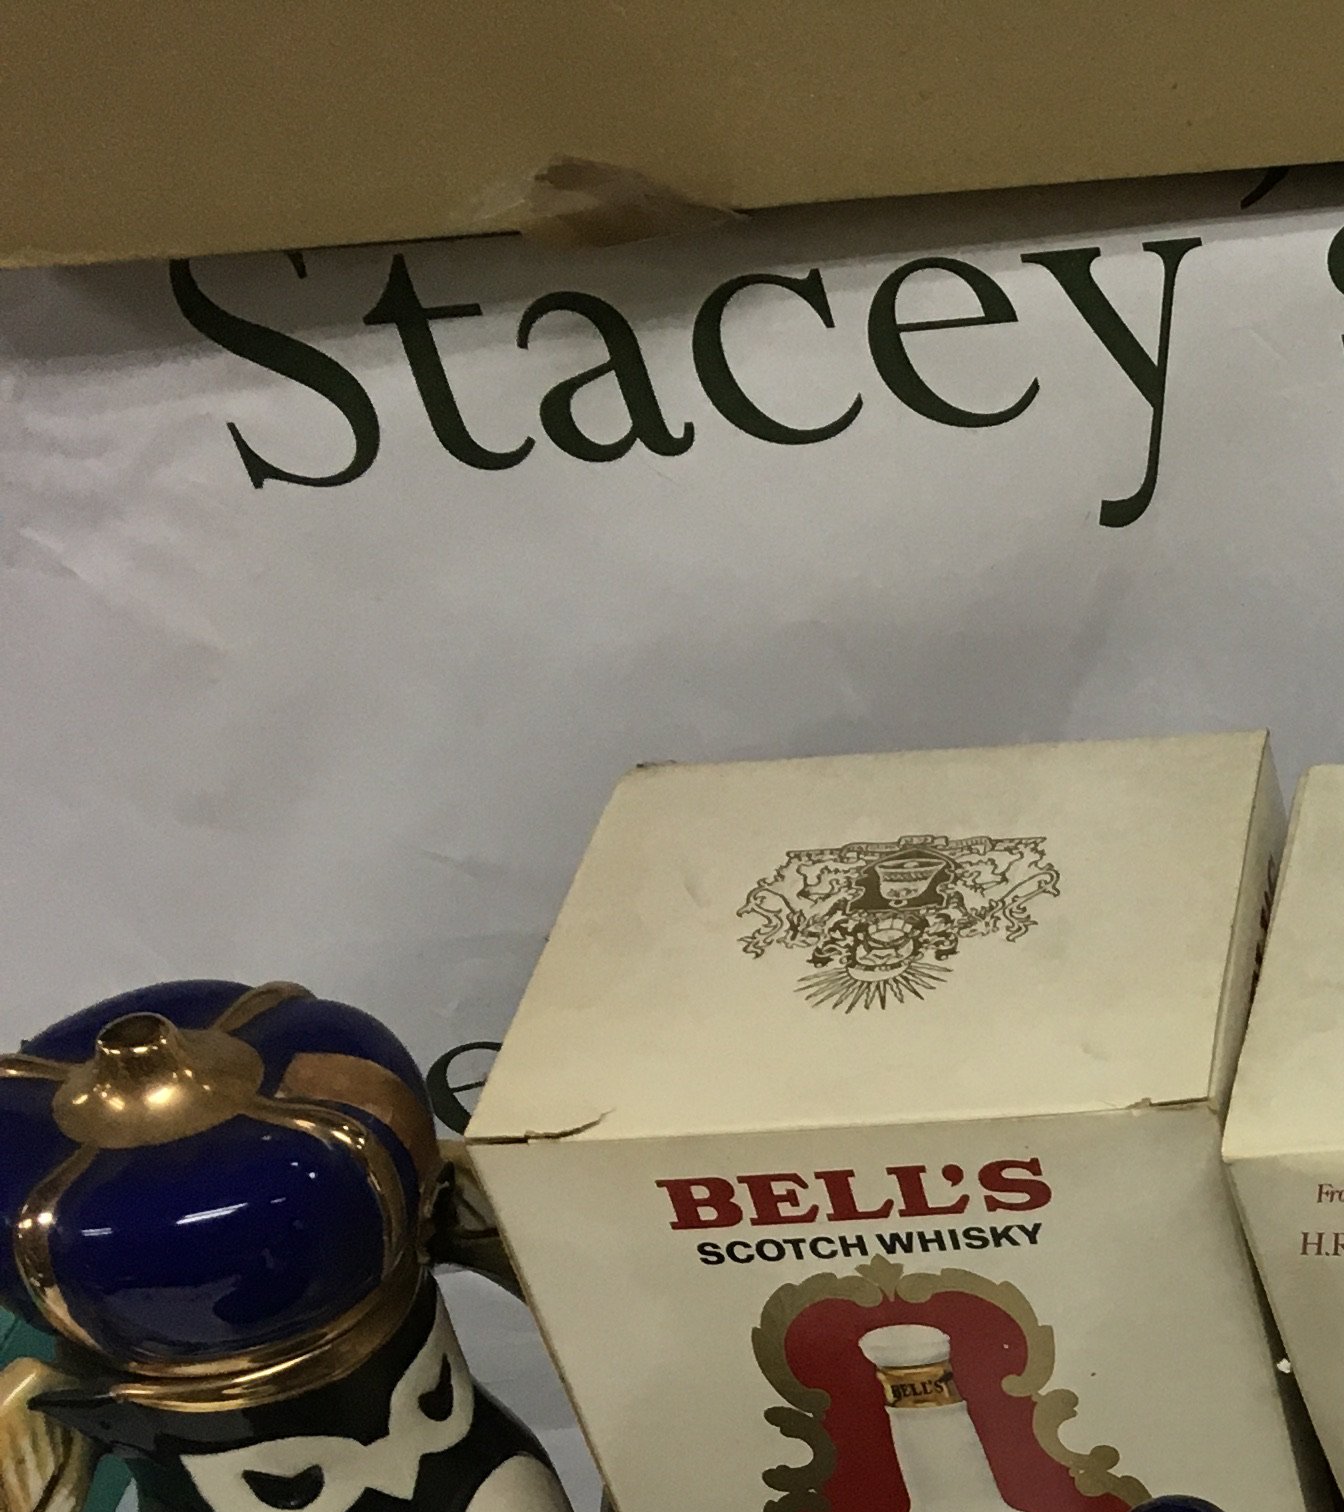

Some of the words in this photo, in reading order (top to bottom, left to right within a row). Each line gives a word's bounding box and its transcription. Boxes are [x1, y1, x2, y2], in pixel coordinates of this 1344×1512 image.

[656, 1157, 1053, 1229] BELL'S
[697, 1234, 869, 1266] SCOTCH
[875, 1223, 1043, 1257] WHISKY
[891, 1380, 943, 1398] BELL'S
